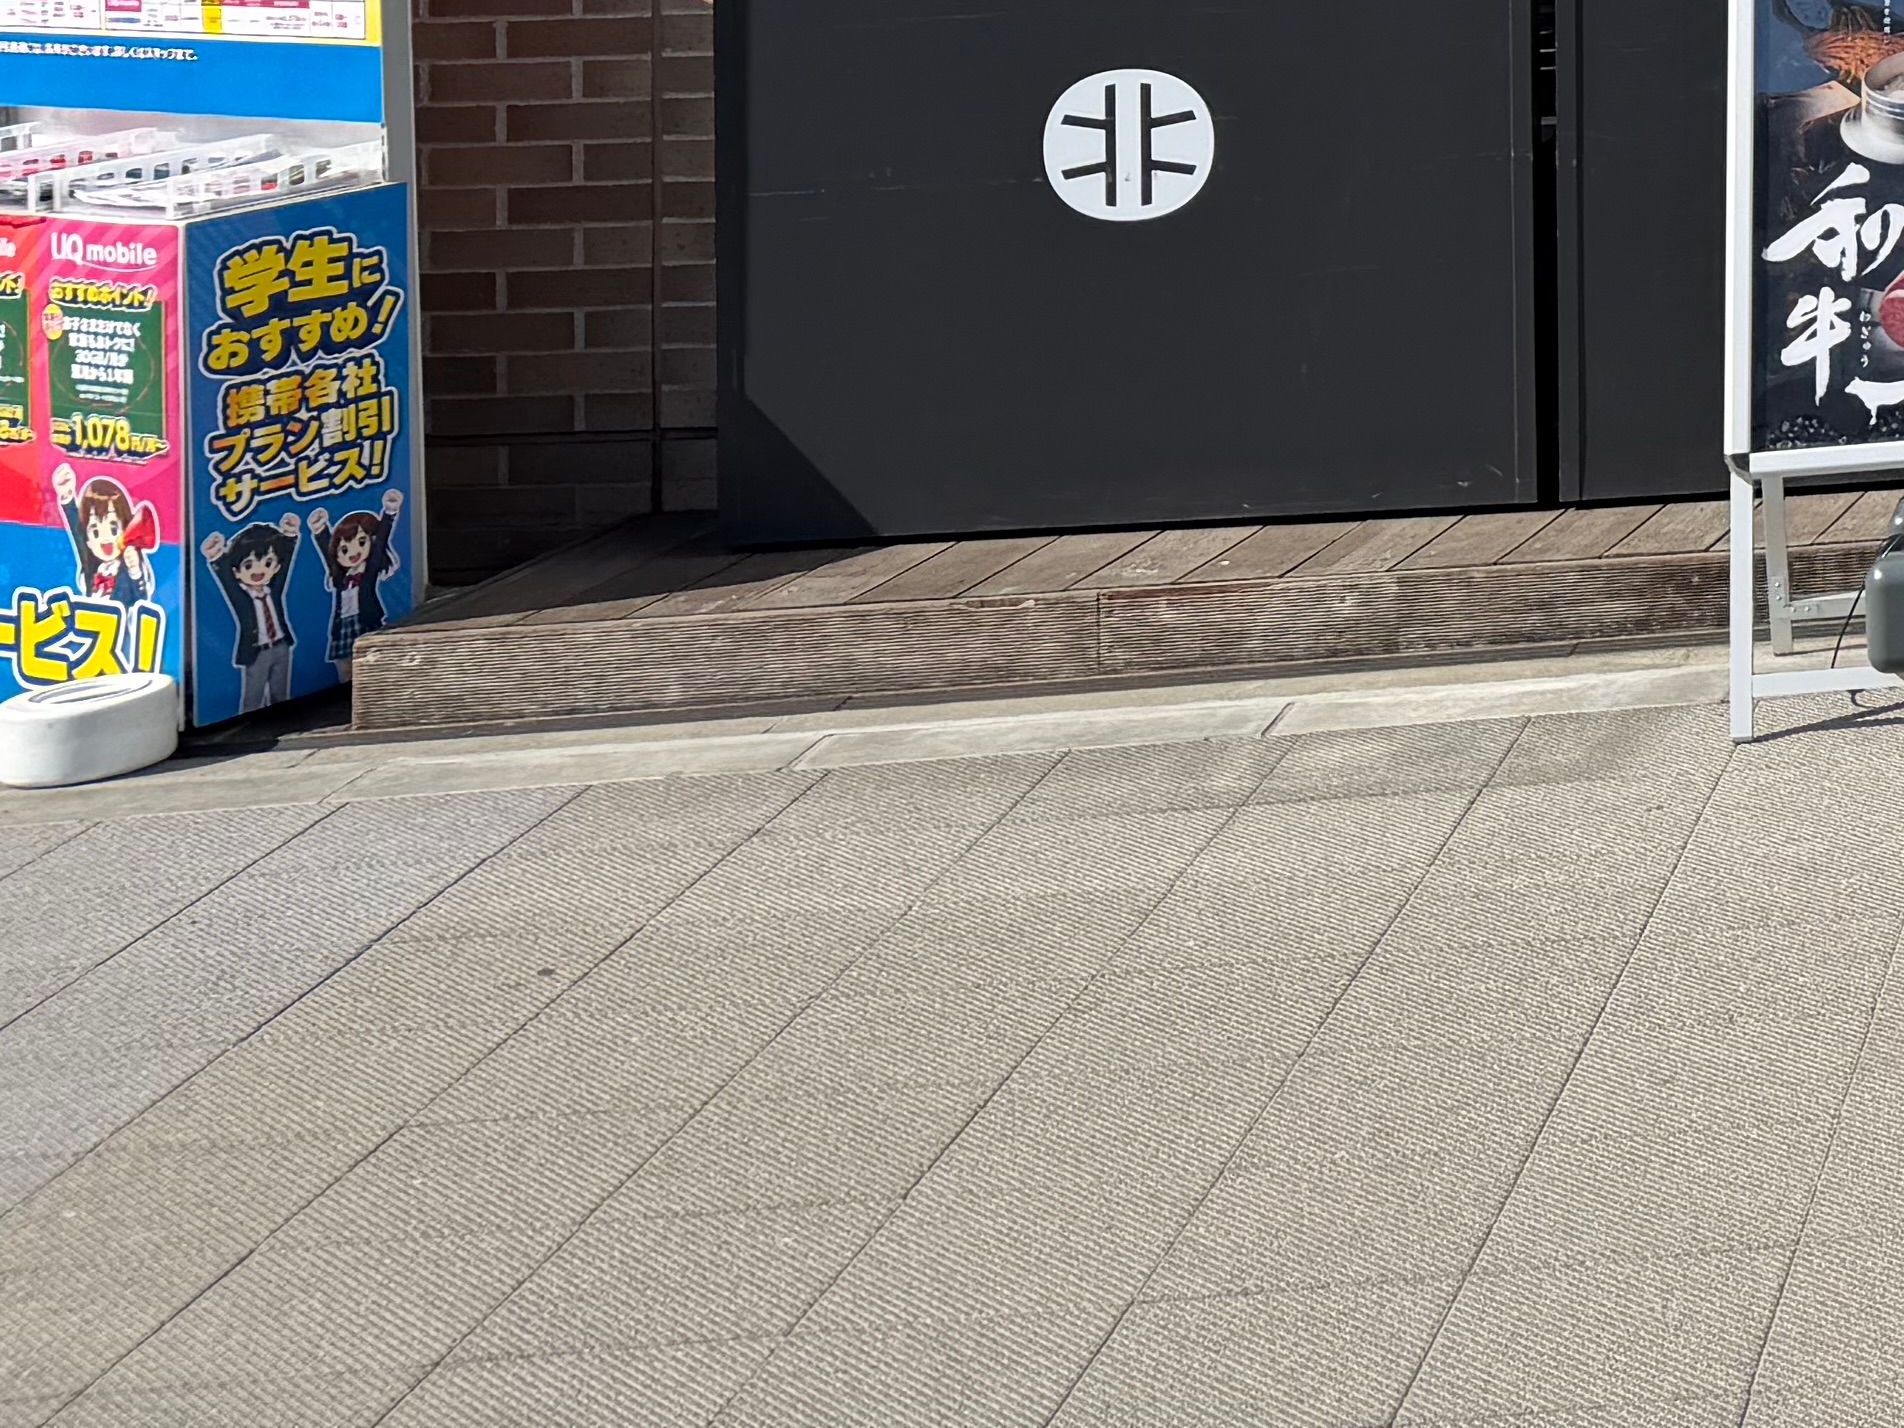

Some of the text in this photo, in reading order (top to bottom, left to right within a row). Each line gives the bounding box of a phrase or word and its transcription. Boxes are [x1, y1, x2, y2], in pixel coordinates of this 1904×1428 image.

[86, 242, 157, 265] mobile
[225, 239, 381, 317] 学生に
[208, 295, 396, 371] おすすめ!
[228, 361, 380, 427] 携帯各社
[213, 395, 392, 469] プラン割引
[219, 444, 385, 510] サービス!
